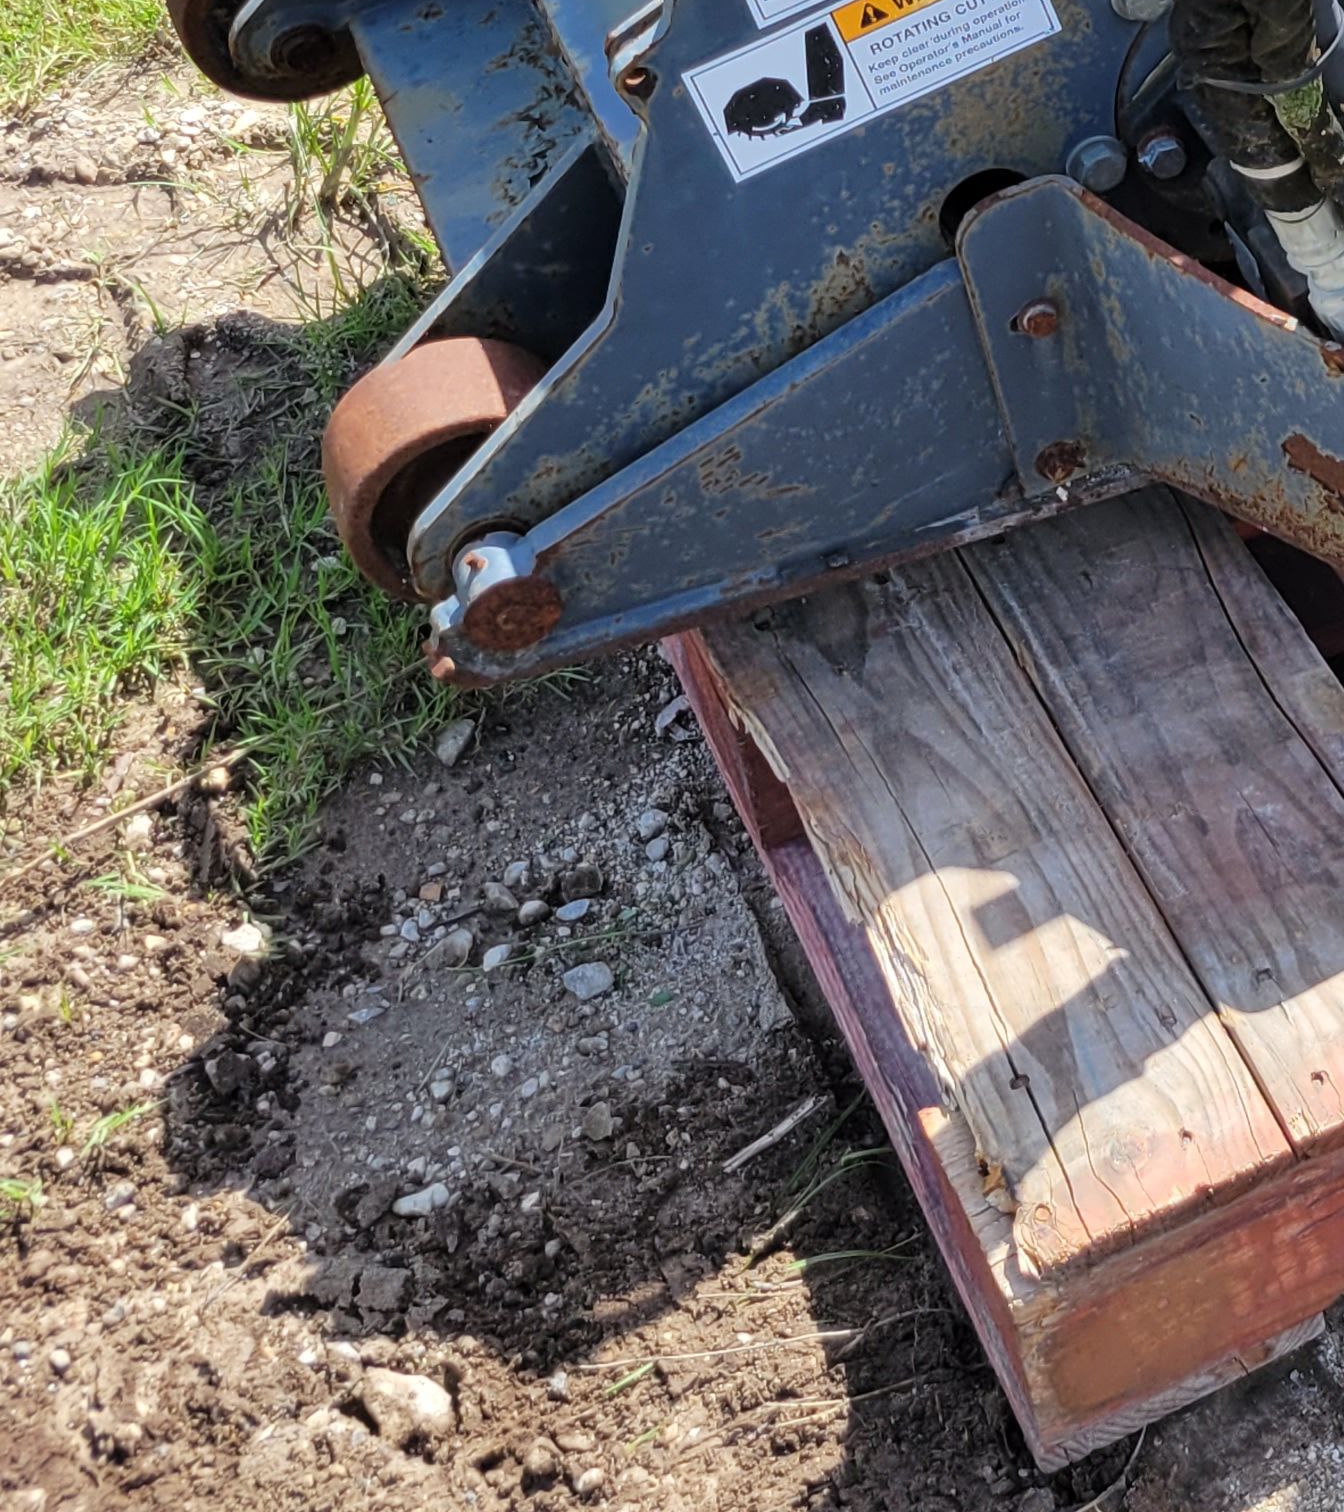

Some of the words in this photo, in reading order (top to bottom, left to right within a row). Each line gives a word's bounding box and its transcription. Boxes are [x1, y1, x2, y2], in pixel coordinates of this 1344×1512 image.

[868, 55, 899, 74] Keep
[902, 41, 929, 59] clear
[932, 22, 970, 45] during
[870, 11, 951, 56] ROTATING
[874, 71, 897, 85] See
[899, 41, 960, 74] Operator's
[962, 19, 1003, 44] Manual
[1004, 11, 1021, 25] for
[879, 58, 951, 96] maintenance
[955, 25, 1024, 64] precautions.
